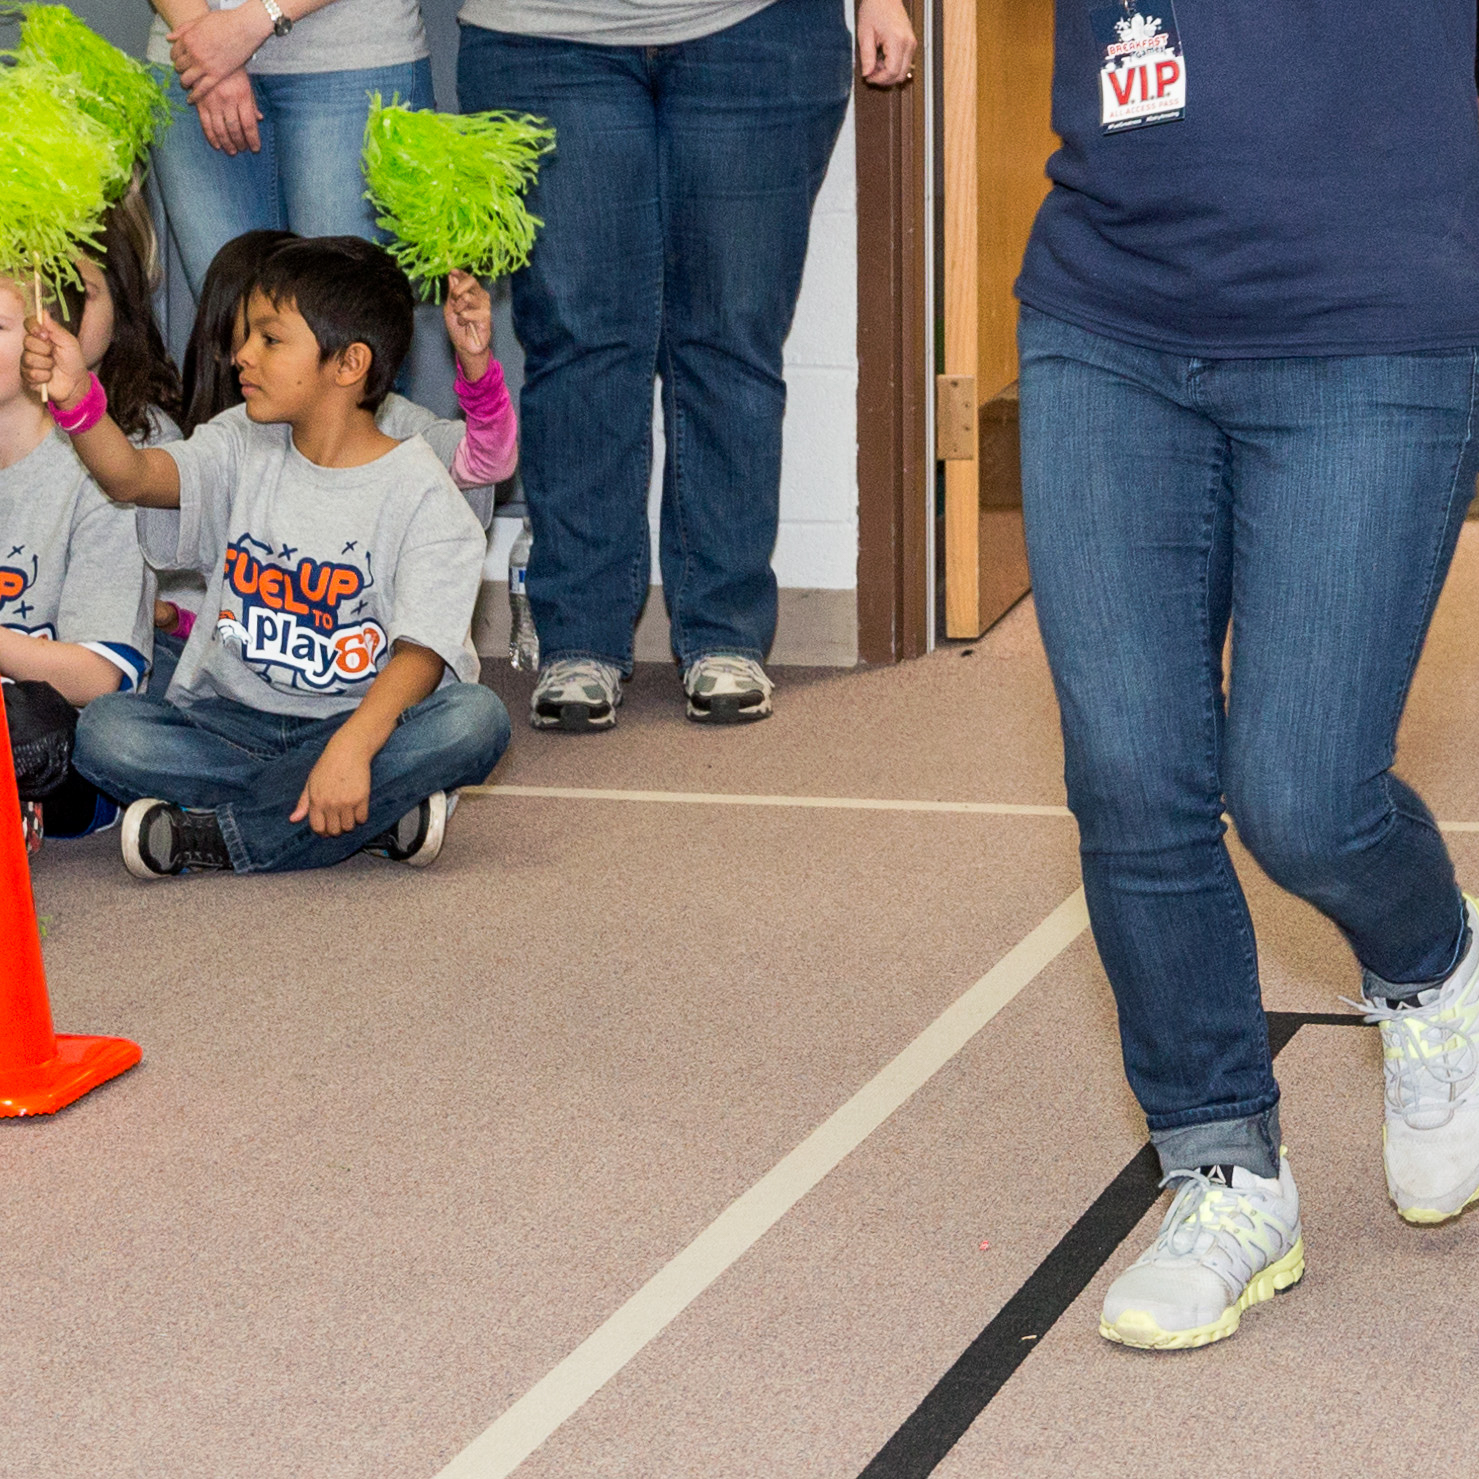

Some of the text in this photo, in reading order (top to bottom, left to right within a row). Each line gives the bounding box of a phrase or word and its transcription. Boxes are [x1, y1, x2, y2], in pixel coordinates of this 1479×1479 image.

[1108, 34, 1168, 56] BREAKFAST
[299, 562, 360, 607] UP
[311, 609, 334, 630] TO
